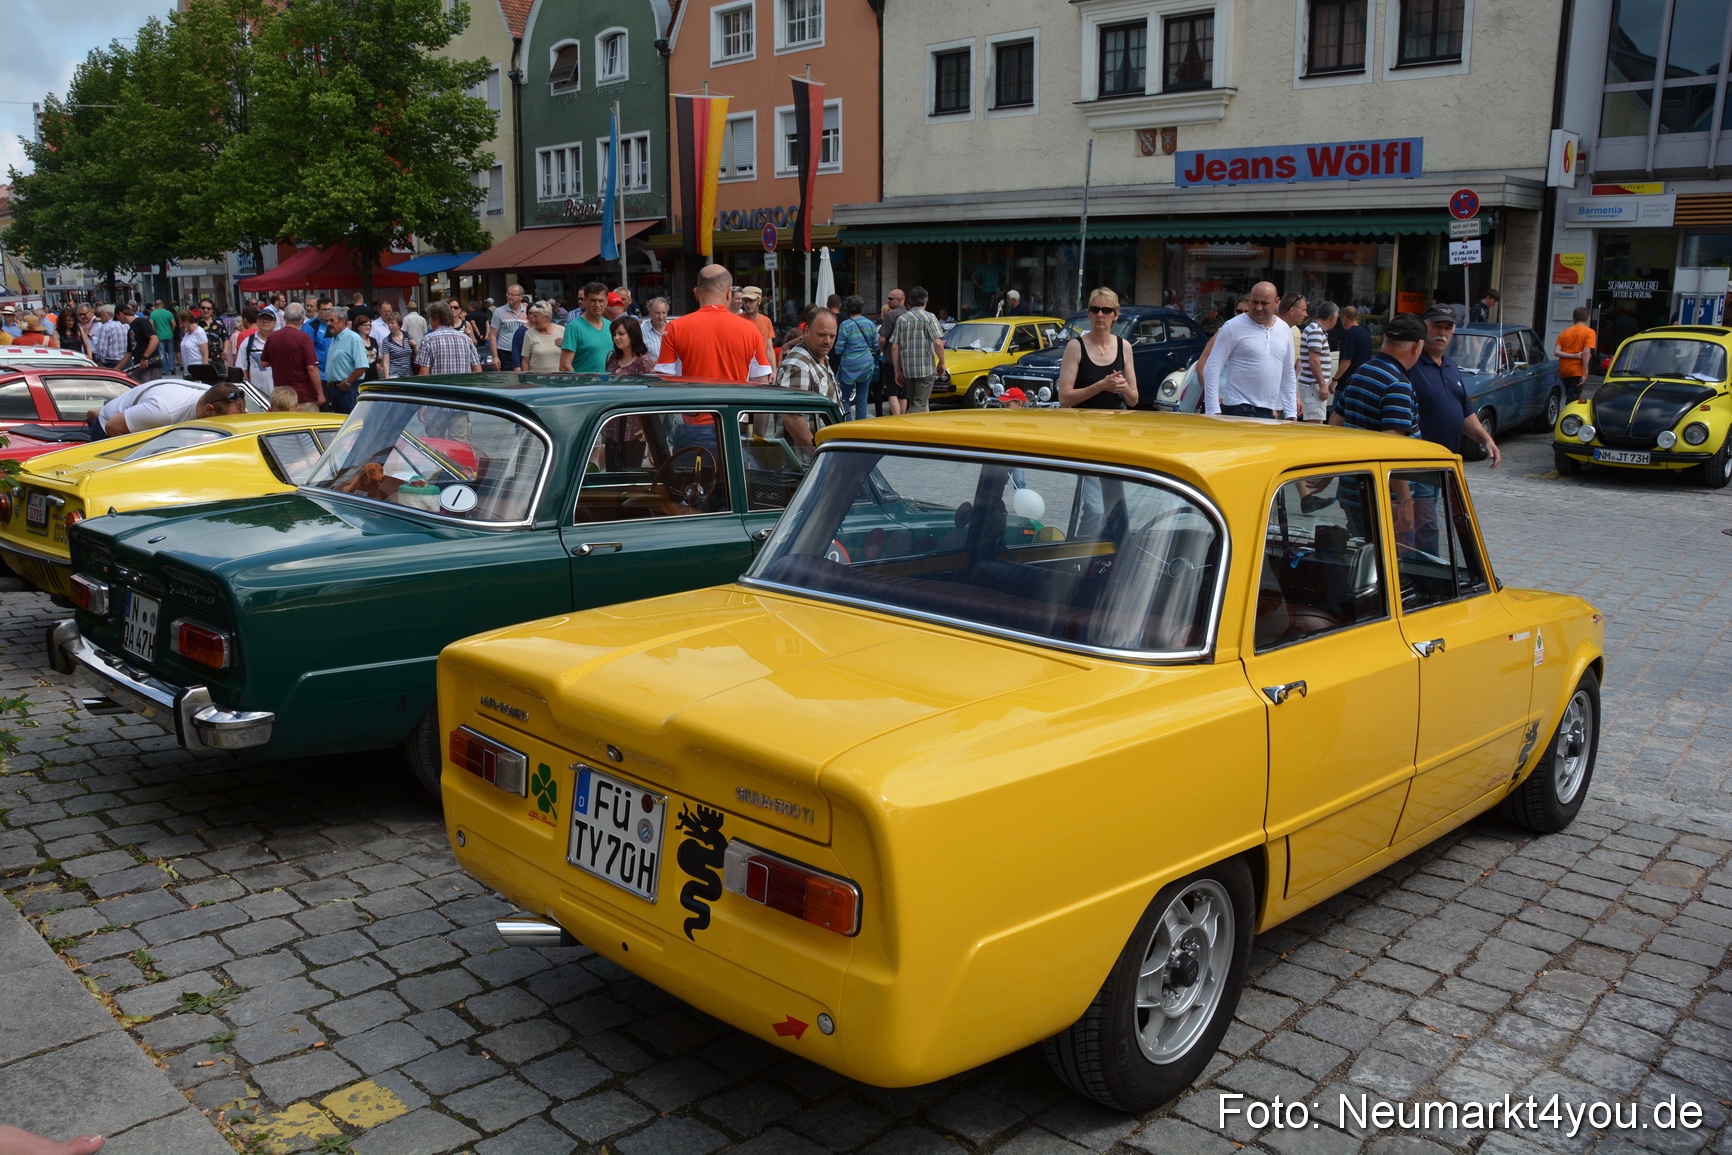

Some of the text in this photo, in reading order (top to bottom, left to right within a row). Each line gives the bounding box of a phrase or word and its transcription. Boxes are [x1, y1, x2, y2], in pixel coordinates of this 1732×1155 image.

[1184, 141, 1412, 182] Jeans Wölfl
[1578, 206, 1623, 215] Barmenia
[719, 205, 801, 232] ROMSTOC
[1607, 280, 1659, 290] SCHWARZMALEREI
[1612, 291, 1628, 299] TATTOO
[1633, 291, 1653, 299] PIERCING
[1687, 298, 1712, 306] HER
[1599, 451, 1649, 463] NM JT 73H
[131, 594, 140, 623] N
[135, 628, 156, 660] 47H
[578, 795, 585, 808] D
